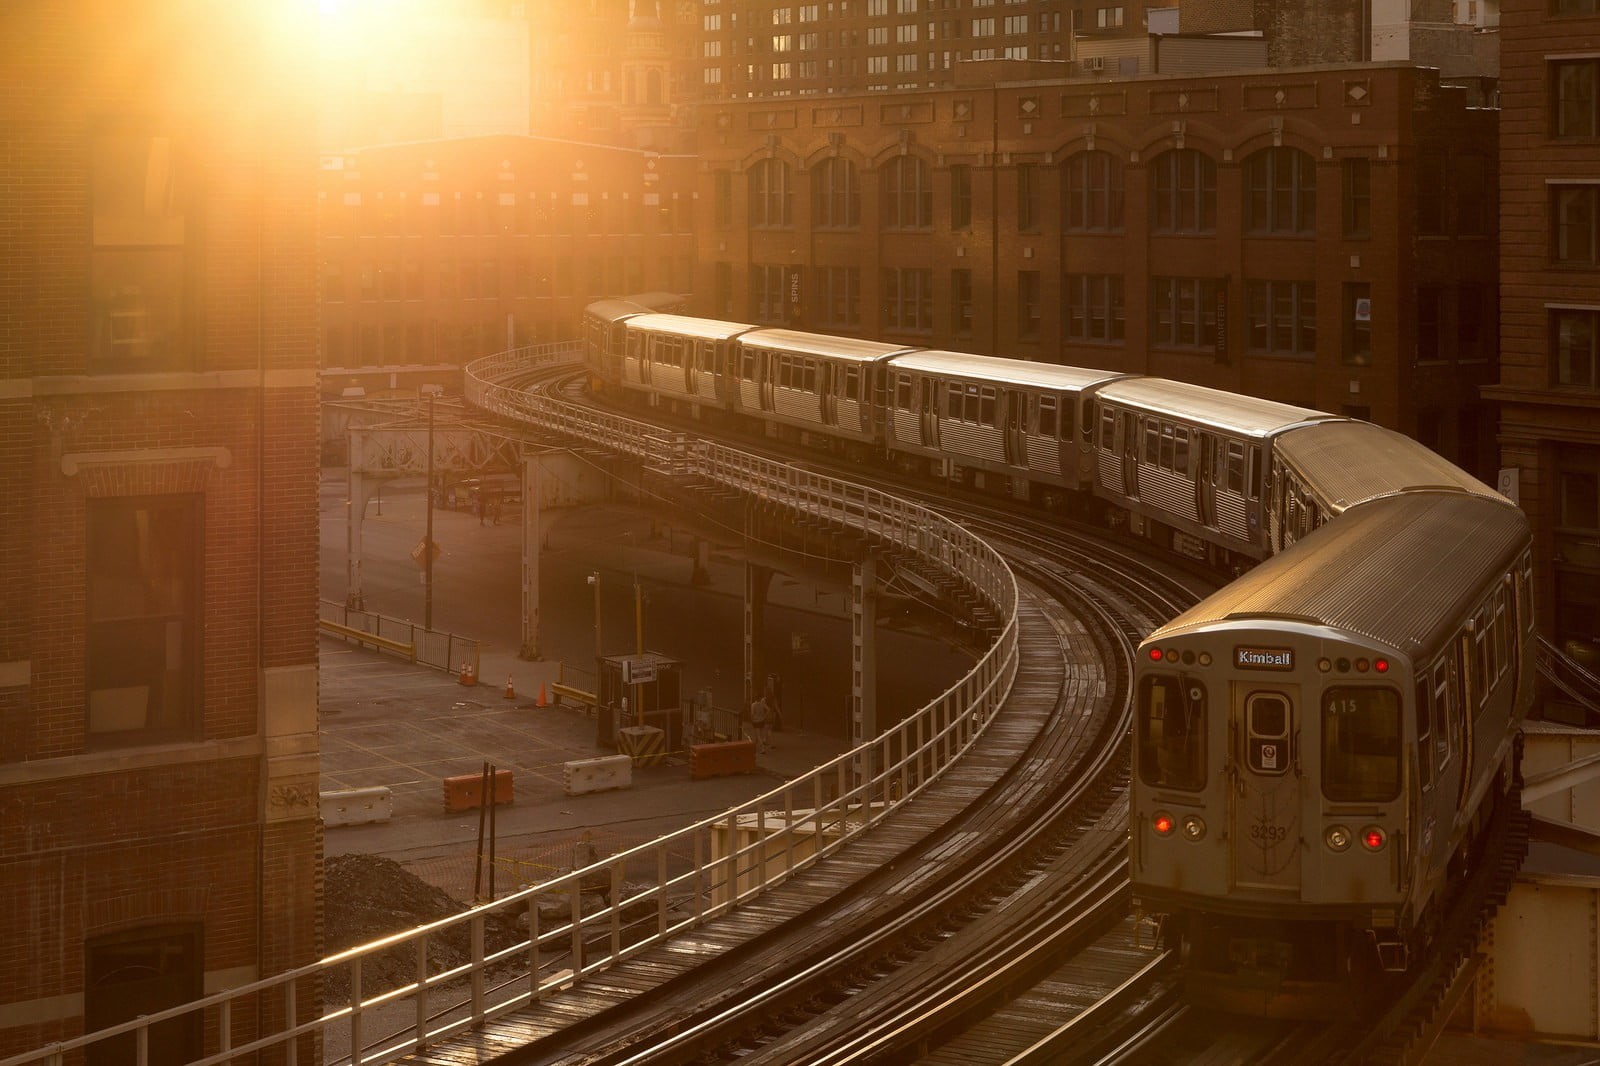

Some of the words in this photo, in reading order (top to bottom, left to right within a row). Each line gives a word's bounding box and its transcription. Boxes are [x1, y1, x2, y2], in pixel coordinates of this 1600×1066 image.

[791, 274, 799, 303] SPINS
[1239, 651, 1291, 664] Kimball
[1329, 700, 1357, 714] 415
[1251, 825, 1286, 841] 3293
